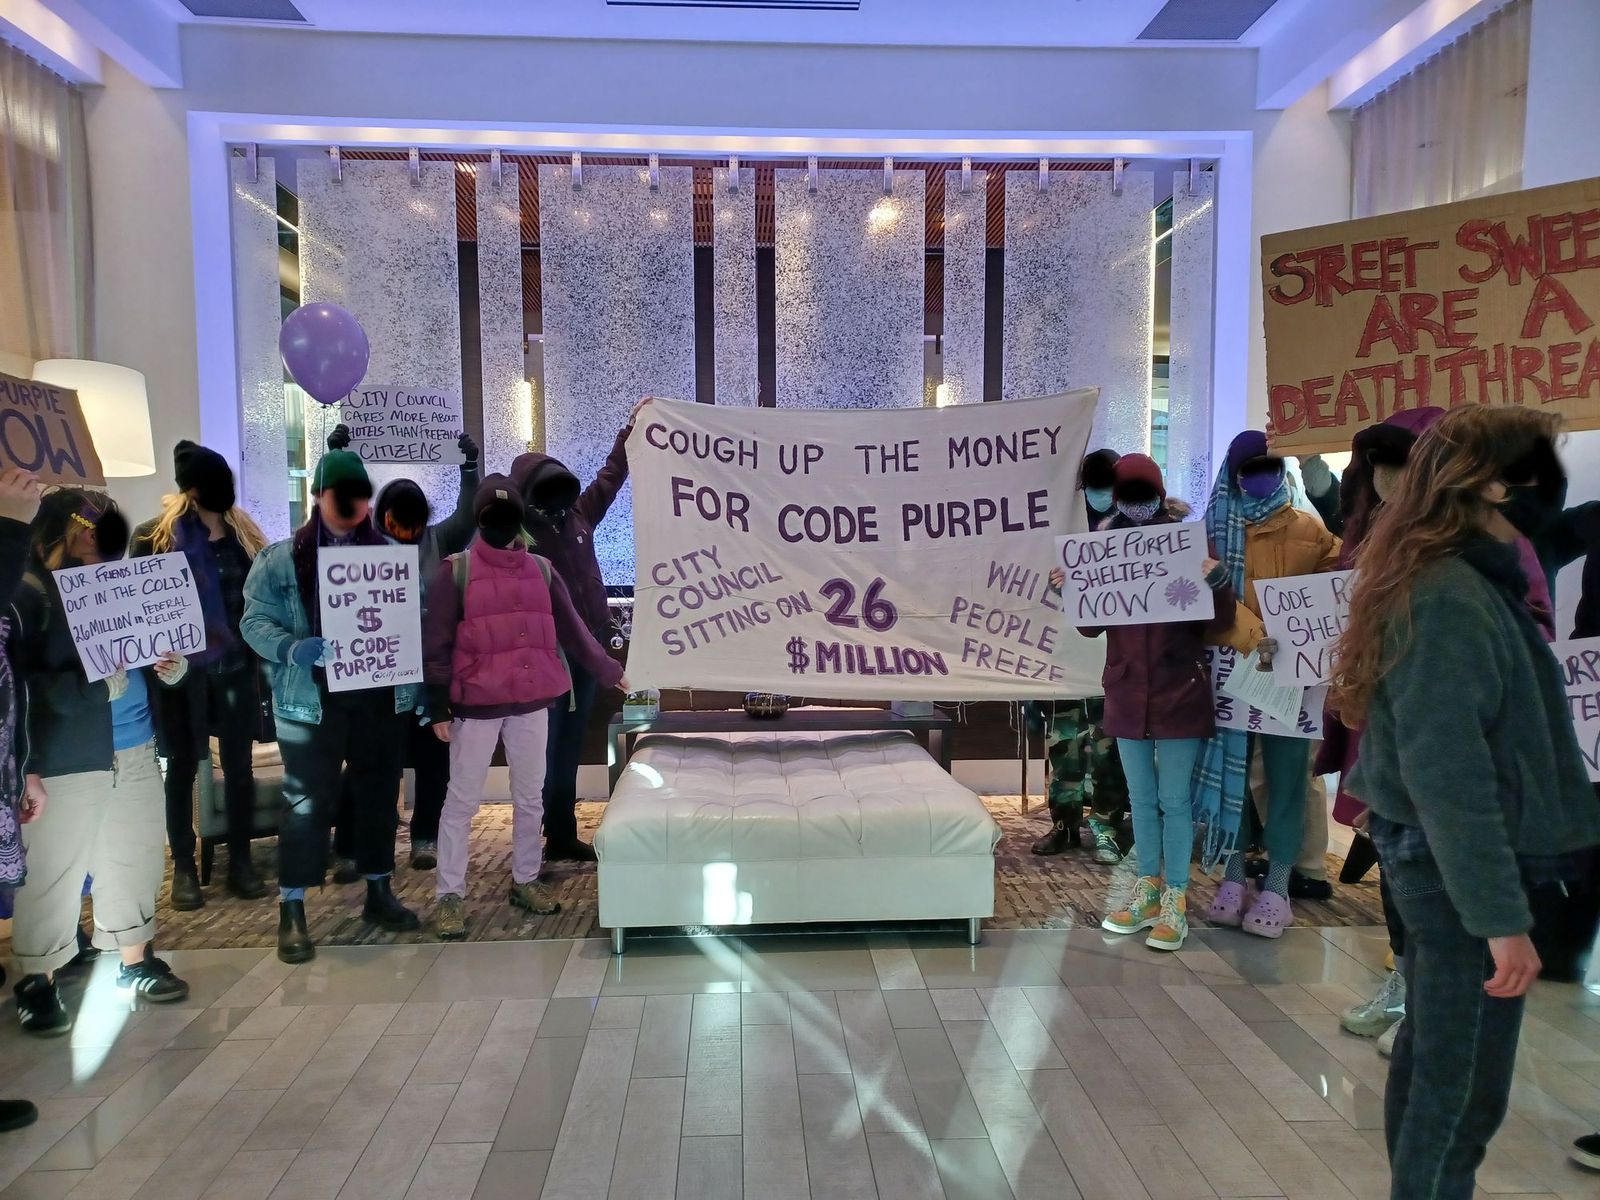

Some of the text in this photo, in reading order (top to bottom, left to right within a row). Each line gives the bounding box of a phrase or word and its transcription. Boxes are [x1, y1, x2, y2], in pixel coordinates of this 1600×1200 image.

[1268, 237, 1439, 307] STREET
[1355, 273, 1595, 357] ARE A
[345, 411, 459, 423] CARES MORE ABOUT
[348, 389, 452, 409] CITY COUNCIL
[0, 408, 87, 478] OW
[387, 424, 419, 438] THAN
[645, 423, 1061, 475] COUGH UP THE MONEY
[360, 442, 442, 461] CITIZENS
[671, 476, 1050, 544] FOR CODE PURPLE
[652, 545, 722, 586] CITY
[1063, 529, 1191, 568] CODE PURPLE
[60, 558, 165, 593] OUR FRIENDS LEFT
[66, 568, 190, 613] OUT IN THE COLD!
[327, 562, 410, 585] COUGH
[657, 562, 783, 619] COUNCIL
[987, 560, 1064, 612] WHIL
[1071, 561, 1168, 592] SHELTERS
[142, 596, 191, 615] FEDERAL
[328, 587, 407, 608] UP THE
[819, 576, 898, 632] 26
[1079, 582, 1155, 619] NOW
[1264, 585, 1315, 616] CODE
[146, 608, 186, 626] RELIEF
[357, 605, 383, 633] $
[662, 590, 813, 656] SITTING ON
[950, 596, 1058, 654] PEOPLE
[86, 623, 202, 674] UNTOUCHED
[350, 634, 400, 656] CODE
[962, 637, 1065, 681] FREEZE
[332, 654, 396, 680] PURPLE
